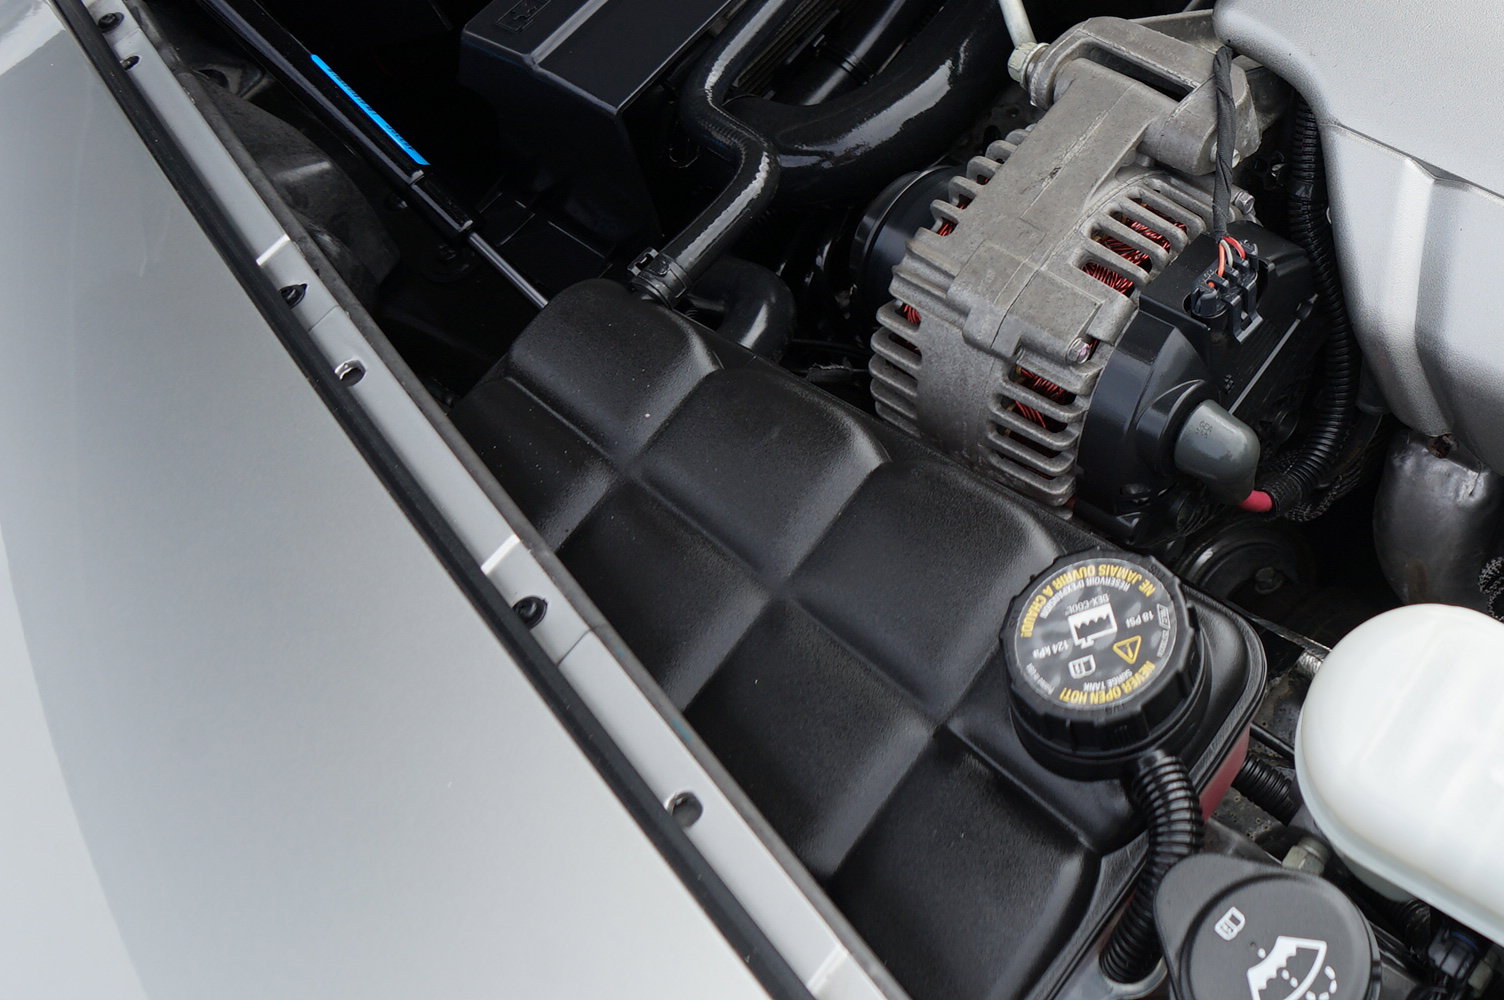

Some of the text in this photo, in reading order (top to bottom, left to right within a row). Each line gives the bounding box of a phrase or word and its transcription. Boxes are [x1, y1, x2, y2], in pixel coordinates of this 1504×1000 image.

[1051, 564, 1096, 590] OUVRIR
[1098, 563, 1143, 585] JAMAIS
[1138, 578, 1157, 598] NE
[1125, 613, 1141, 629] PSI
[1051, 639, 1069, 655] 124
[1059, 660, 1157, 705] NEVER OPEN HOT!
[1083, 668, 1133, 692] SURGE TANK
